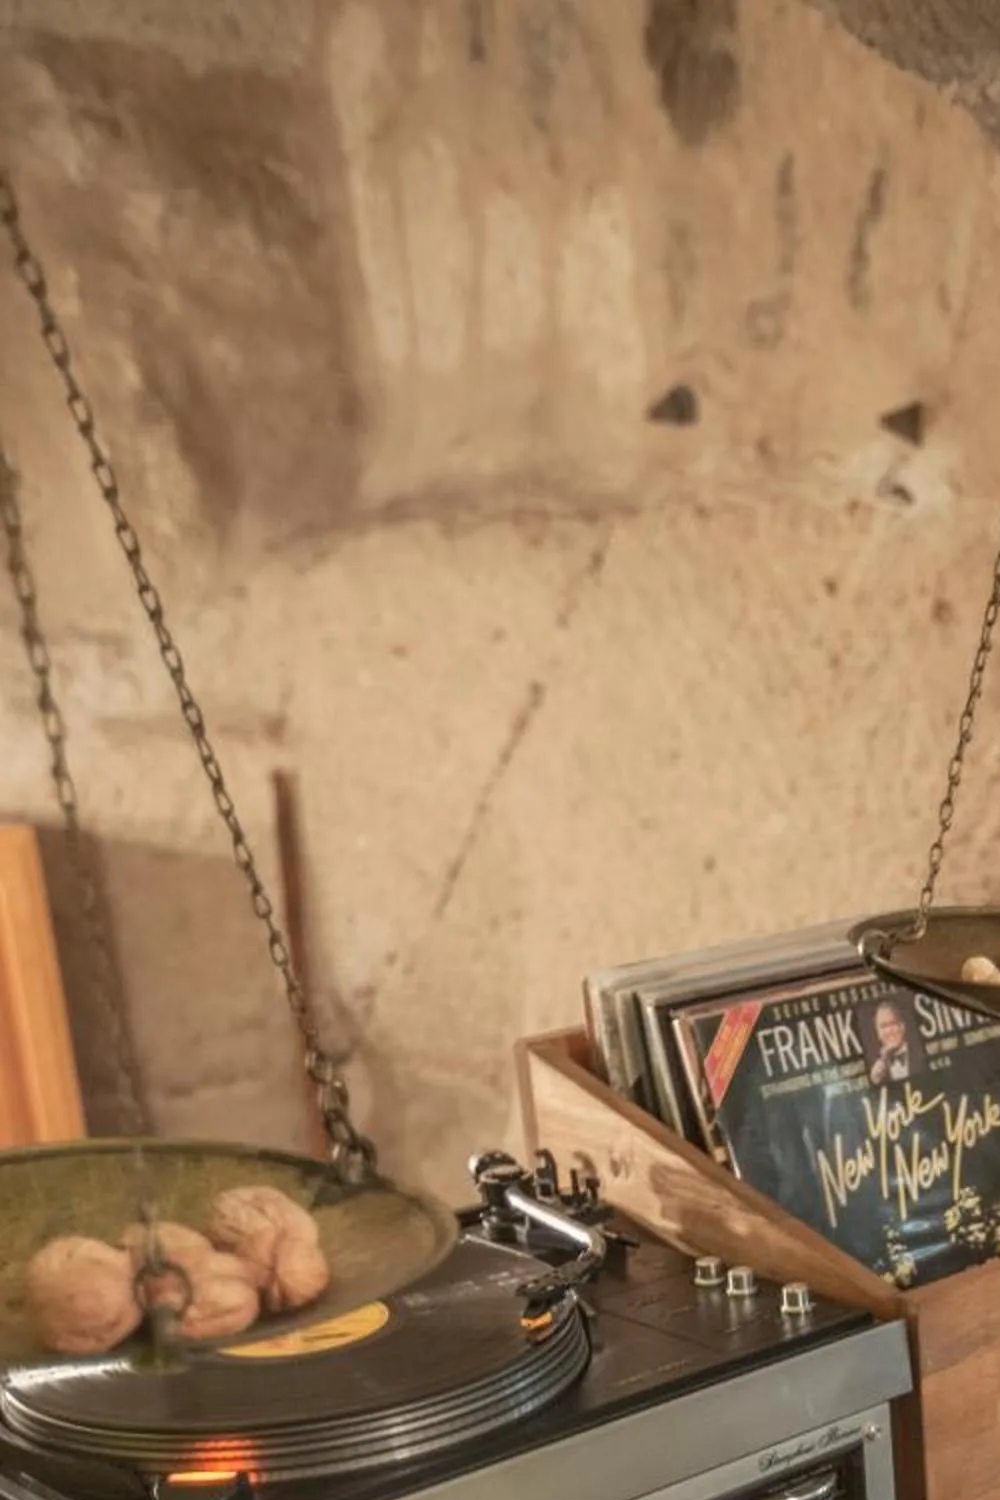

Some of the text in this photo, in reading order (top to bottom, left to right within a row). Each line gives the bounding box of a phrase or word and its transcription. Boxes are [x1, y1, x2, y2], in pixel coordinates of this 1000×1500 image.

[756, 1009, 864, 1077] FRANK
[816, 1082, 945, 1228] New York
[894, 1132, 949, 1220] New
